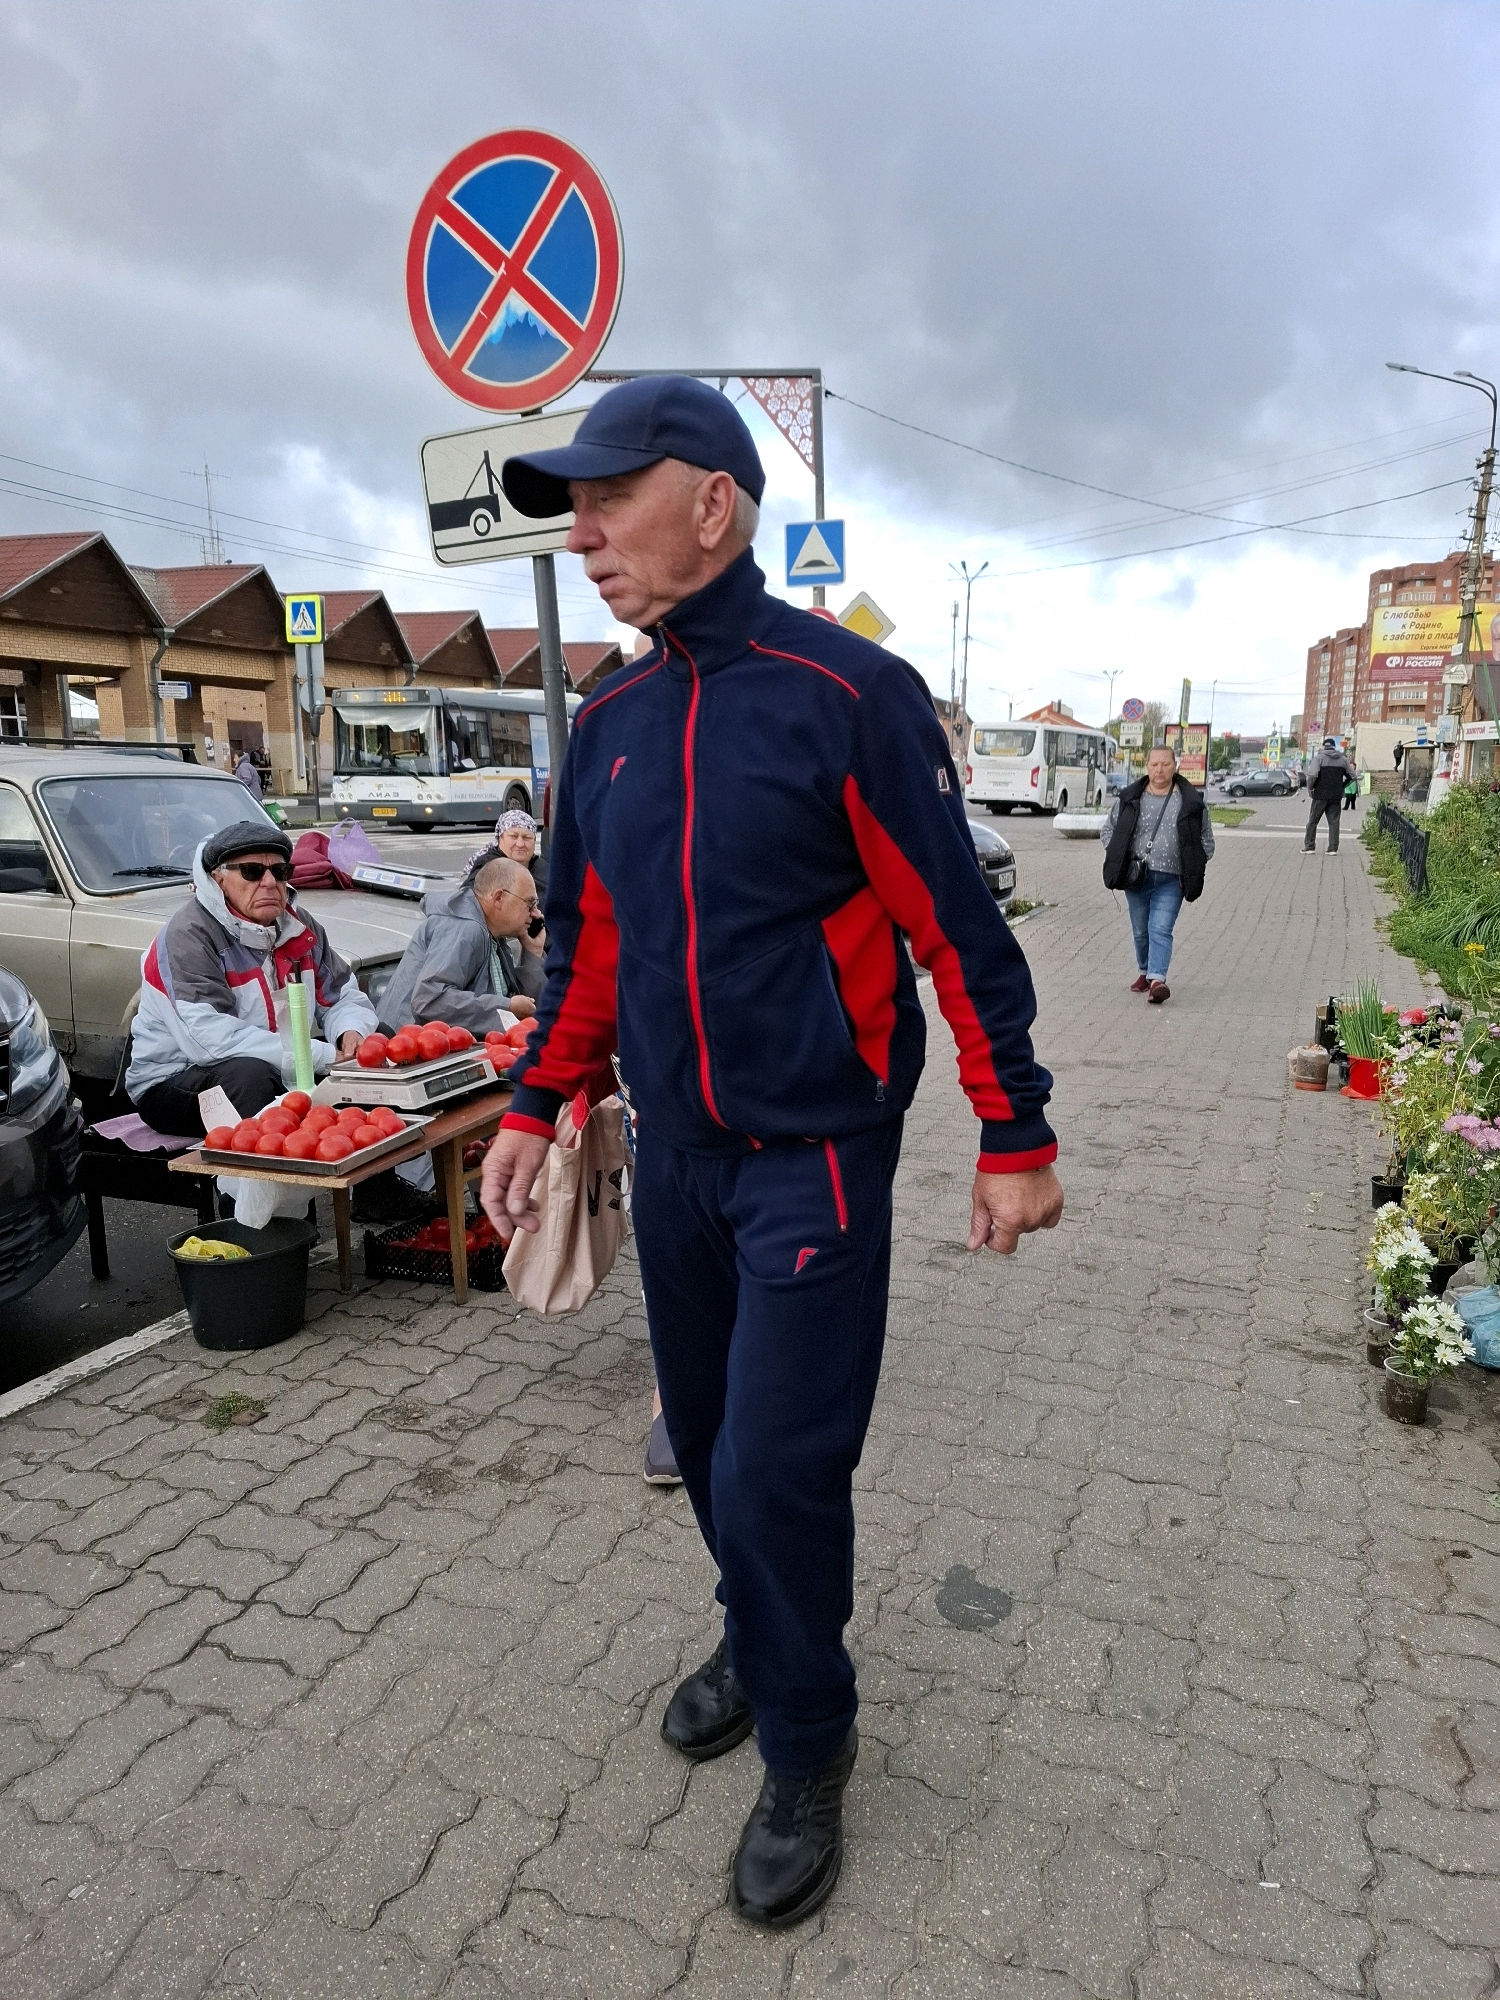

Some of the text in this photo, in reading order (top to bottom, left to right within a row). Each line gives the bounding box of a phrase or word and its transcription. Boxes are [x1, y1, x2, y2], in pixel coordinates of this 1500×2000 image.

[1383, 610, 1432, 619] С любовью
[1409, 621, 1444, 630] Родине,
[1389, 631, 1425, 640] заботой
[1434, 632, 1459, 641] людя
[1405, 660, 1443, 668] РОССИЯ
